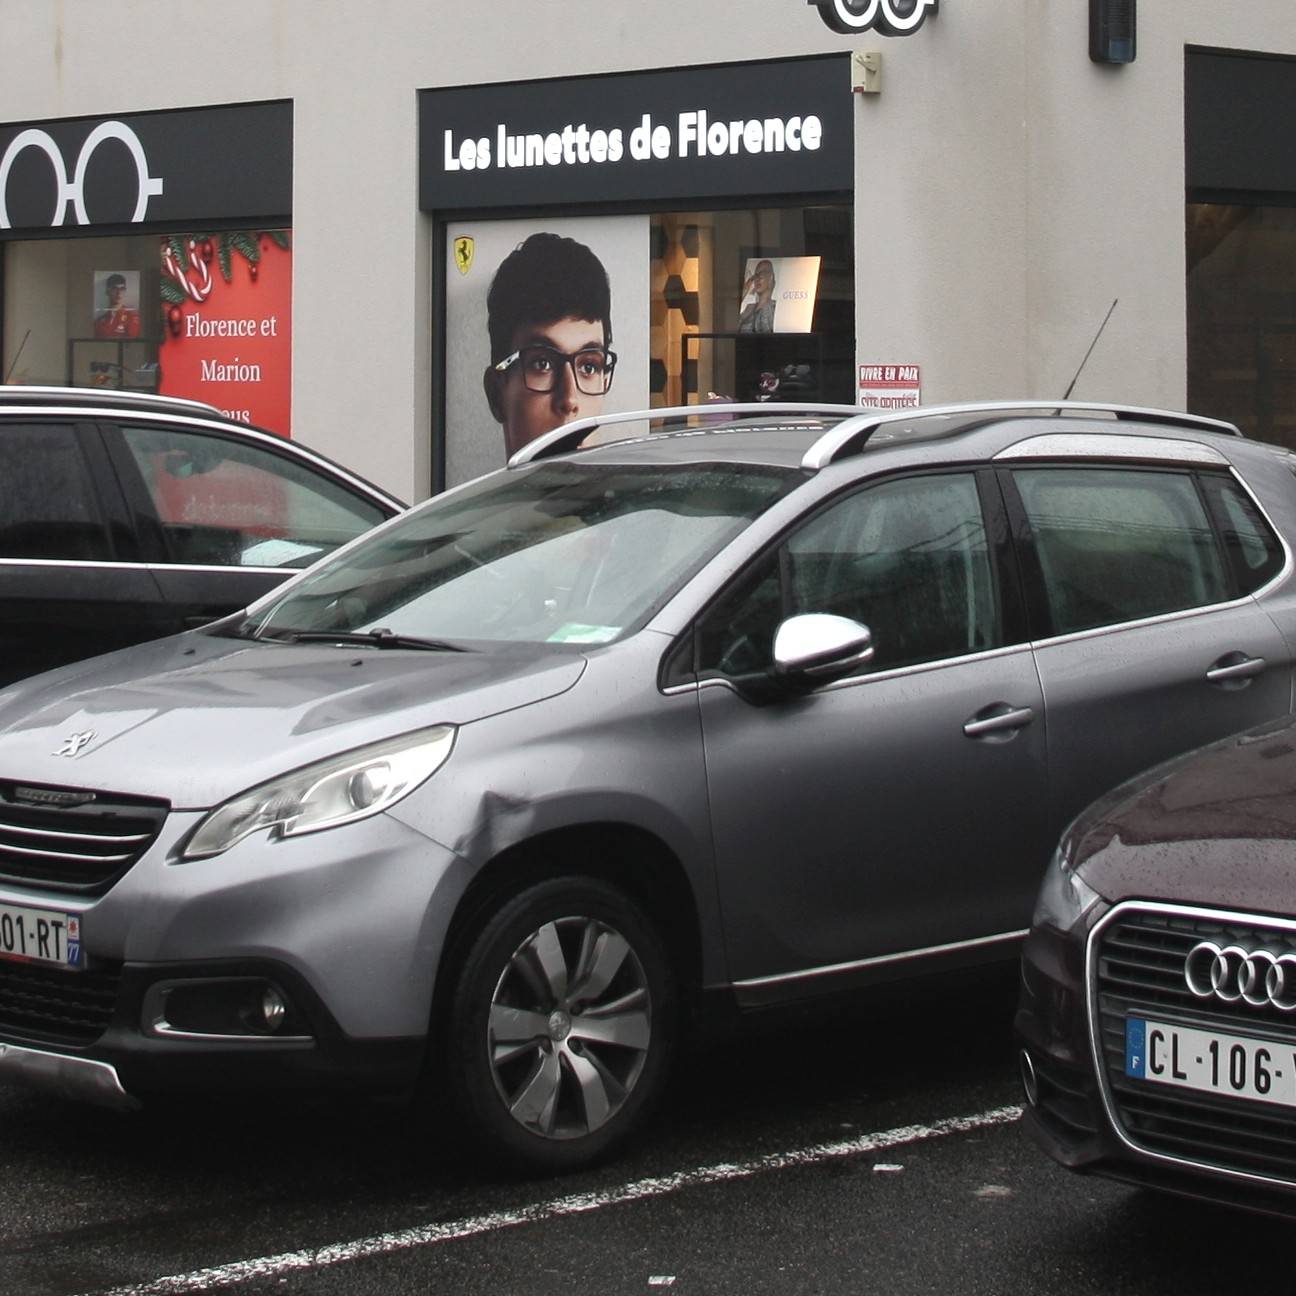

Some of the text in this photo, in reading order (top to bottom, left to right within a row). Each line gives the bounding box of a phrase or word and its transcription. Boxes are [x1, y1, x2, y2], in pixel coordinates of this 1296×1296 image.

[444, 109, 822, 171] Les lunettes de Florence
[186, 312, 277, 337] Florence et
[200, 358, 261, 382] Marion
[221, 409, 250, 424] ous
